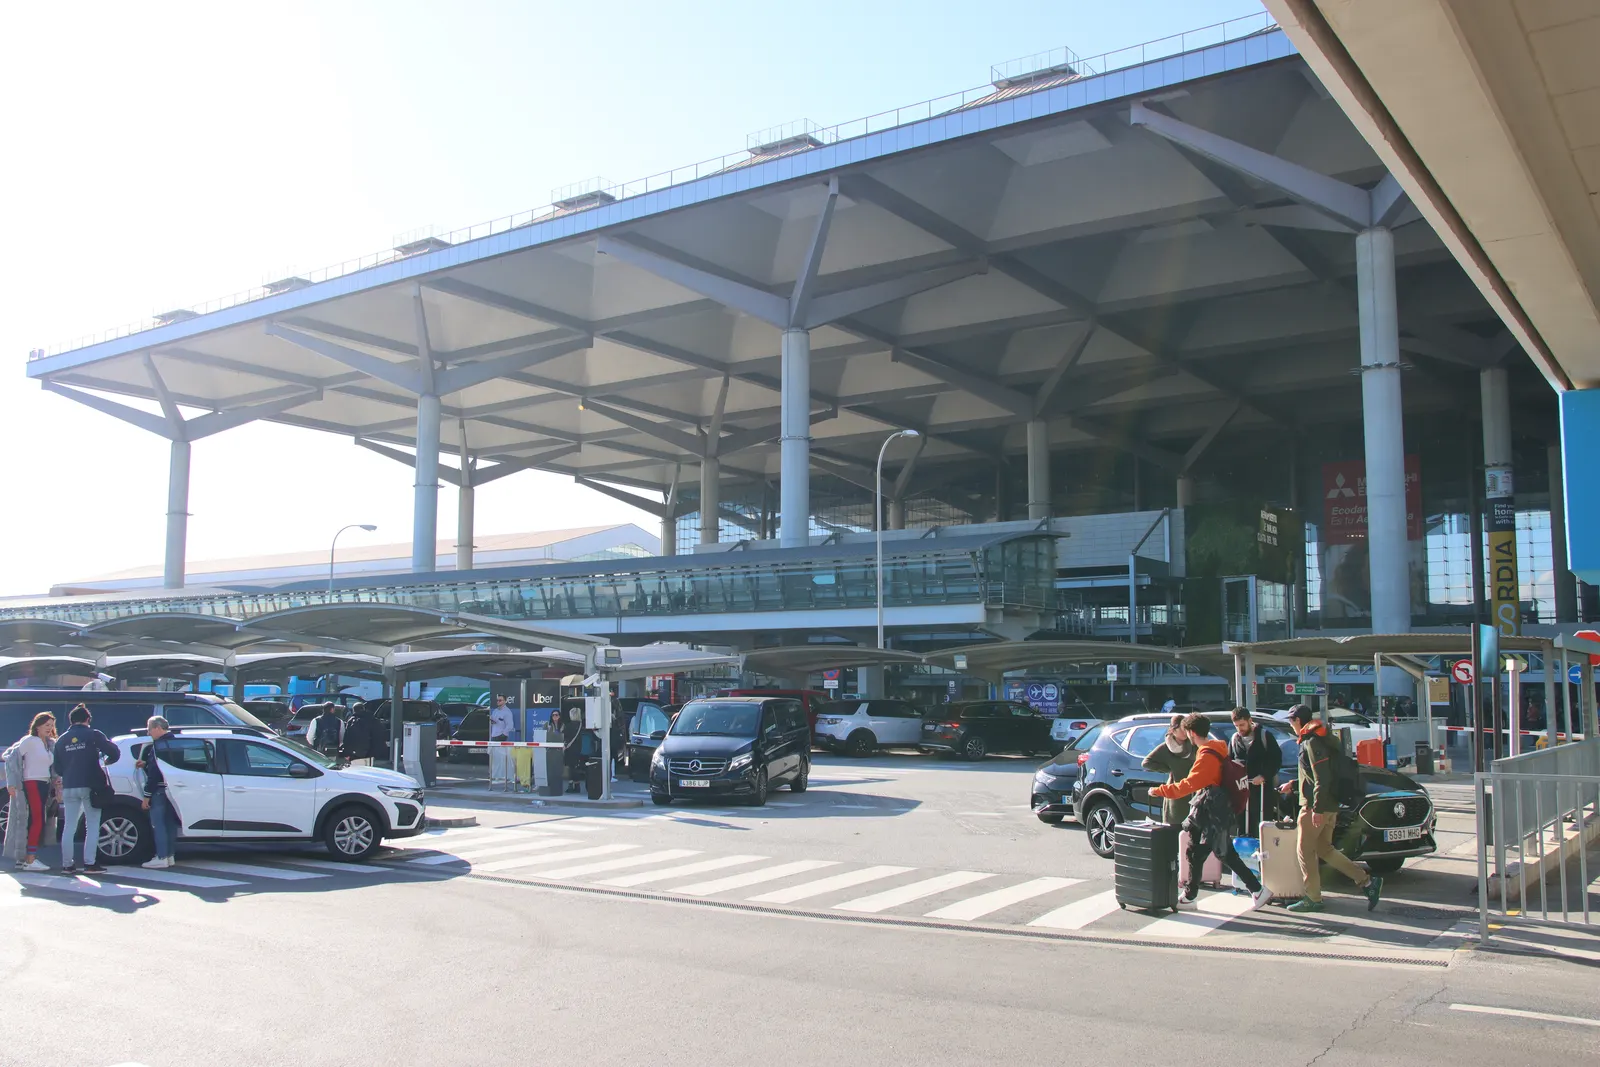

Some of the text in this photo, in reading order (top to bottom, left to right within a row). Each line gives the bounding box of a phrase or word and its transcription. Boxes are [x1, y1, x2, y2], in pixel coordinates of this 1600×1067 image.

[533, 693, 553, 704] Uber
[1235, 775, 1249, 790] VAN
[1388, 830, 1406, 840] 5591
